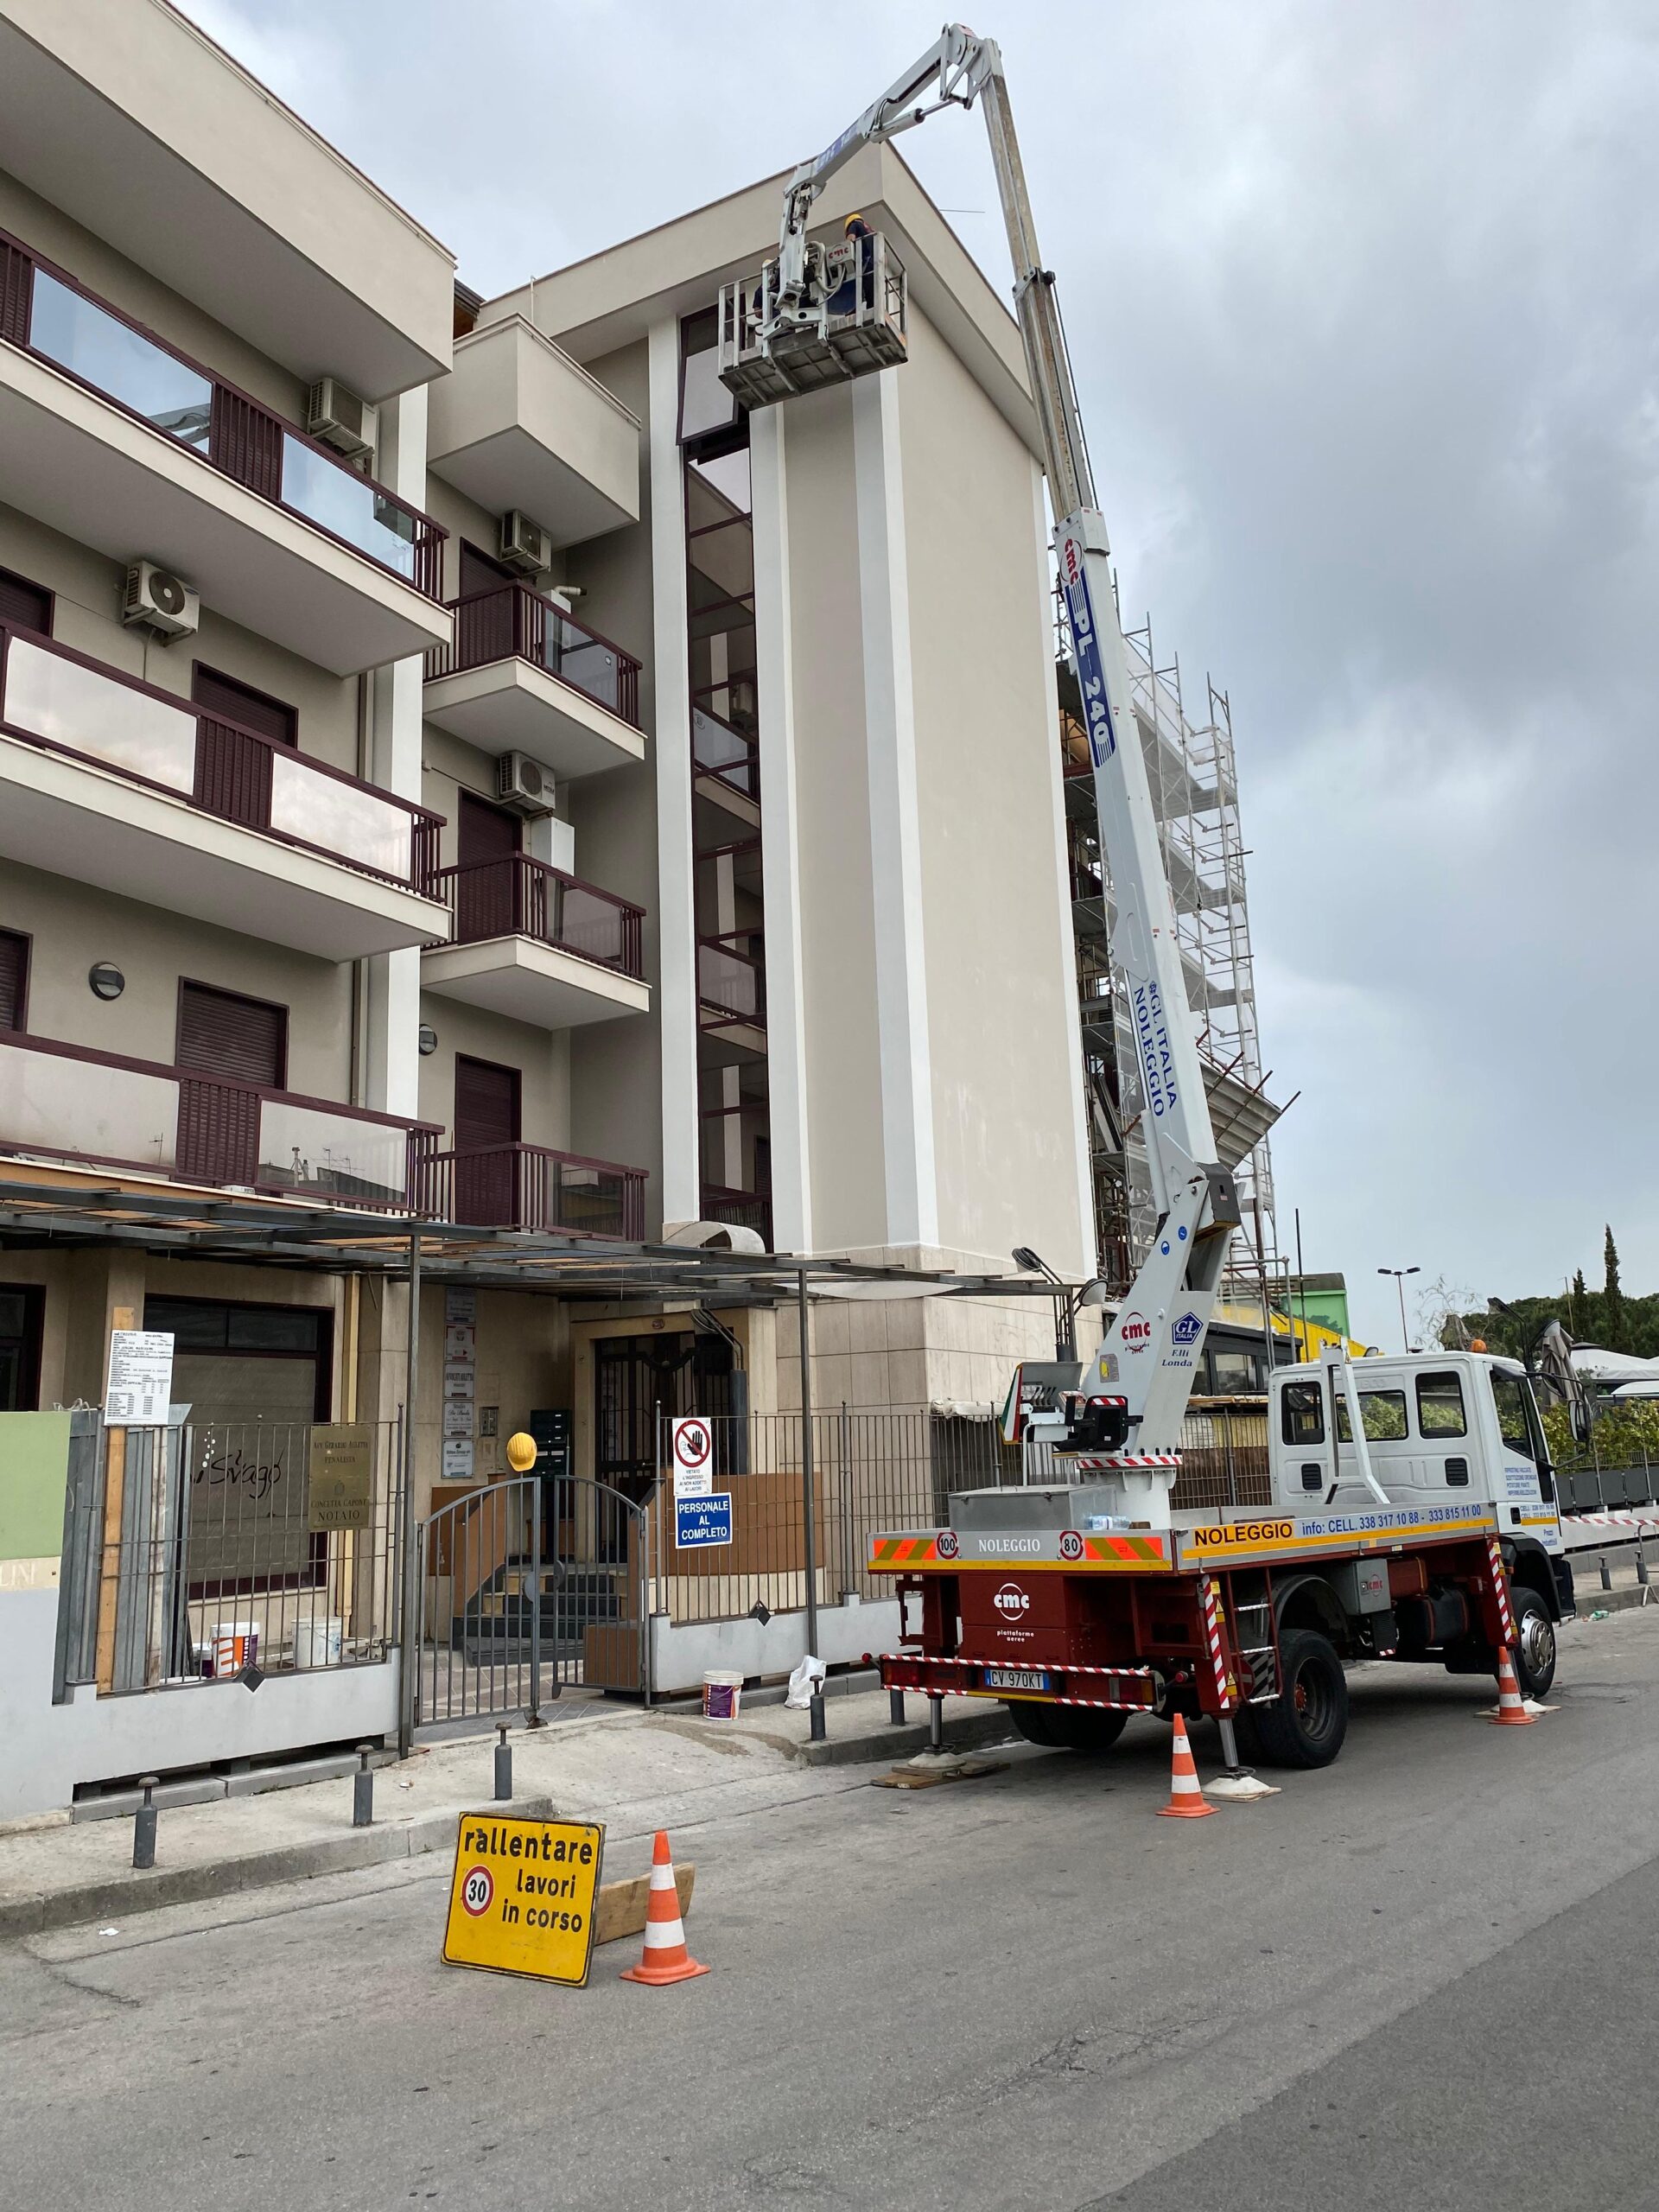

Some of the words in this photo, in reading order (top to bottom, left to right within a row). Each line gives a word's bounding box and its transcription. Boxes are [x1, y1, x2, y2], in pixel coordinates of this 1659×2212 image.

[1065, 538, 1079, 585] cmc
[1075, 611, 1093, 657] PL
[1085, 676, 1109, 744] 240
[1135, 986, 1165, 1116] NOLEGGIO
[1150, 994, 1162, 1023] GL
[1156, 1027, 1178, 1109] ITALIA
[1122, 1322, 1151, 1340] cmc
[1175, 1320, 1198, 1333] GL
[318, 1510, 360, 1522] NOTAIO
[678, 1500, 728, 1514] PERSONALE
[699, 1515, 710, 1525] AL
[1194, 1522, 1293, 1547] NOLEGGIO
[1301, 1522, 1325, 1535] info:
[1328, 1519, 1357, 1533] CELL.
[1359, 1516, 1376, 1529] 338
[1378, 1515, 1393, 1527] 317
[1396, 1513, 1407, 1525] 10
[1408, 1511, 1419, 1523] 88
[1428, 1509, 1444, 1522] 333
[1446, 1507, 1459, 1520] 815
[1461, 1506, 1470, 1517] 11
[1471, 1504, 1481, 1516] 00
[681, 1526, 728, 1540] COMPLETO
[939, 1538, 955, 1551] 100
[978, 1539, 1040, 1552] NOLEGGIO
[1064, 1538, 1077, 1552] 80
[994, 1593, 1030, 1609] cmc
[991, 1671, 1004, 1685] CV
[1008, 1672, 1042, 1688] 970KT
[464, 1827, 593, 1865] rallentare
[468, 1878, 486, 1902] 30
[517, 1869, 576, 1898] lavori
[501, 1897, 519, 1923] in
[526, 1908, 582, 1933] corso
